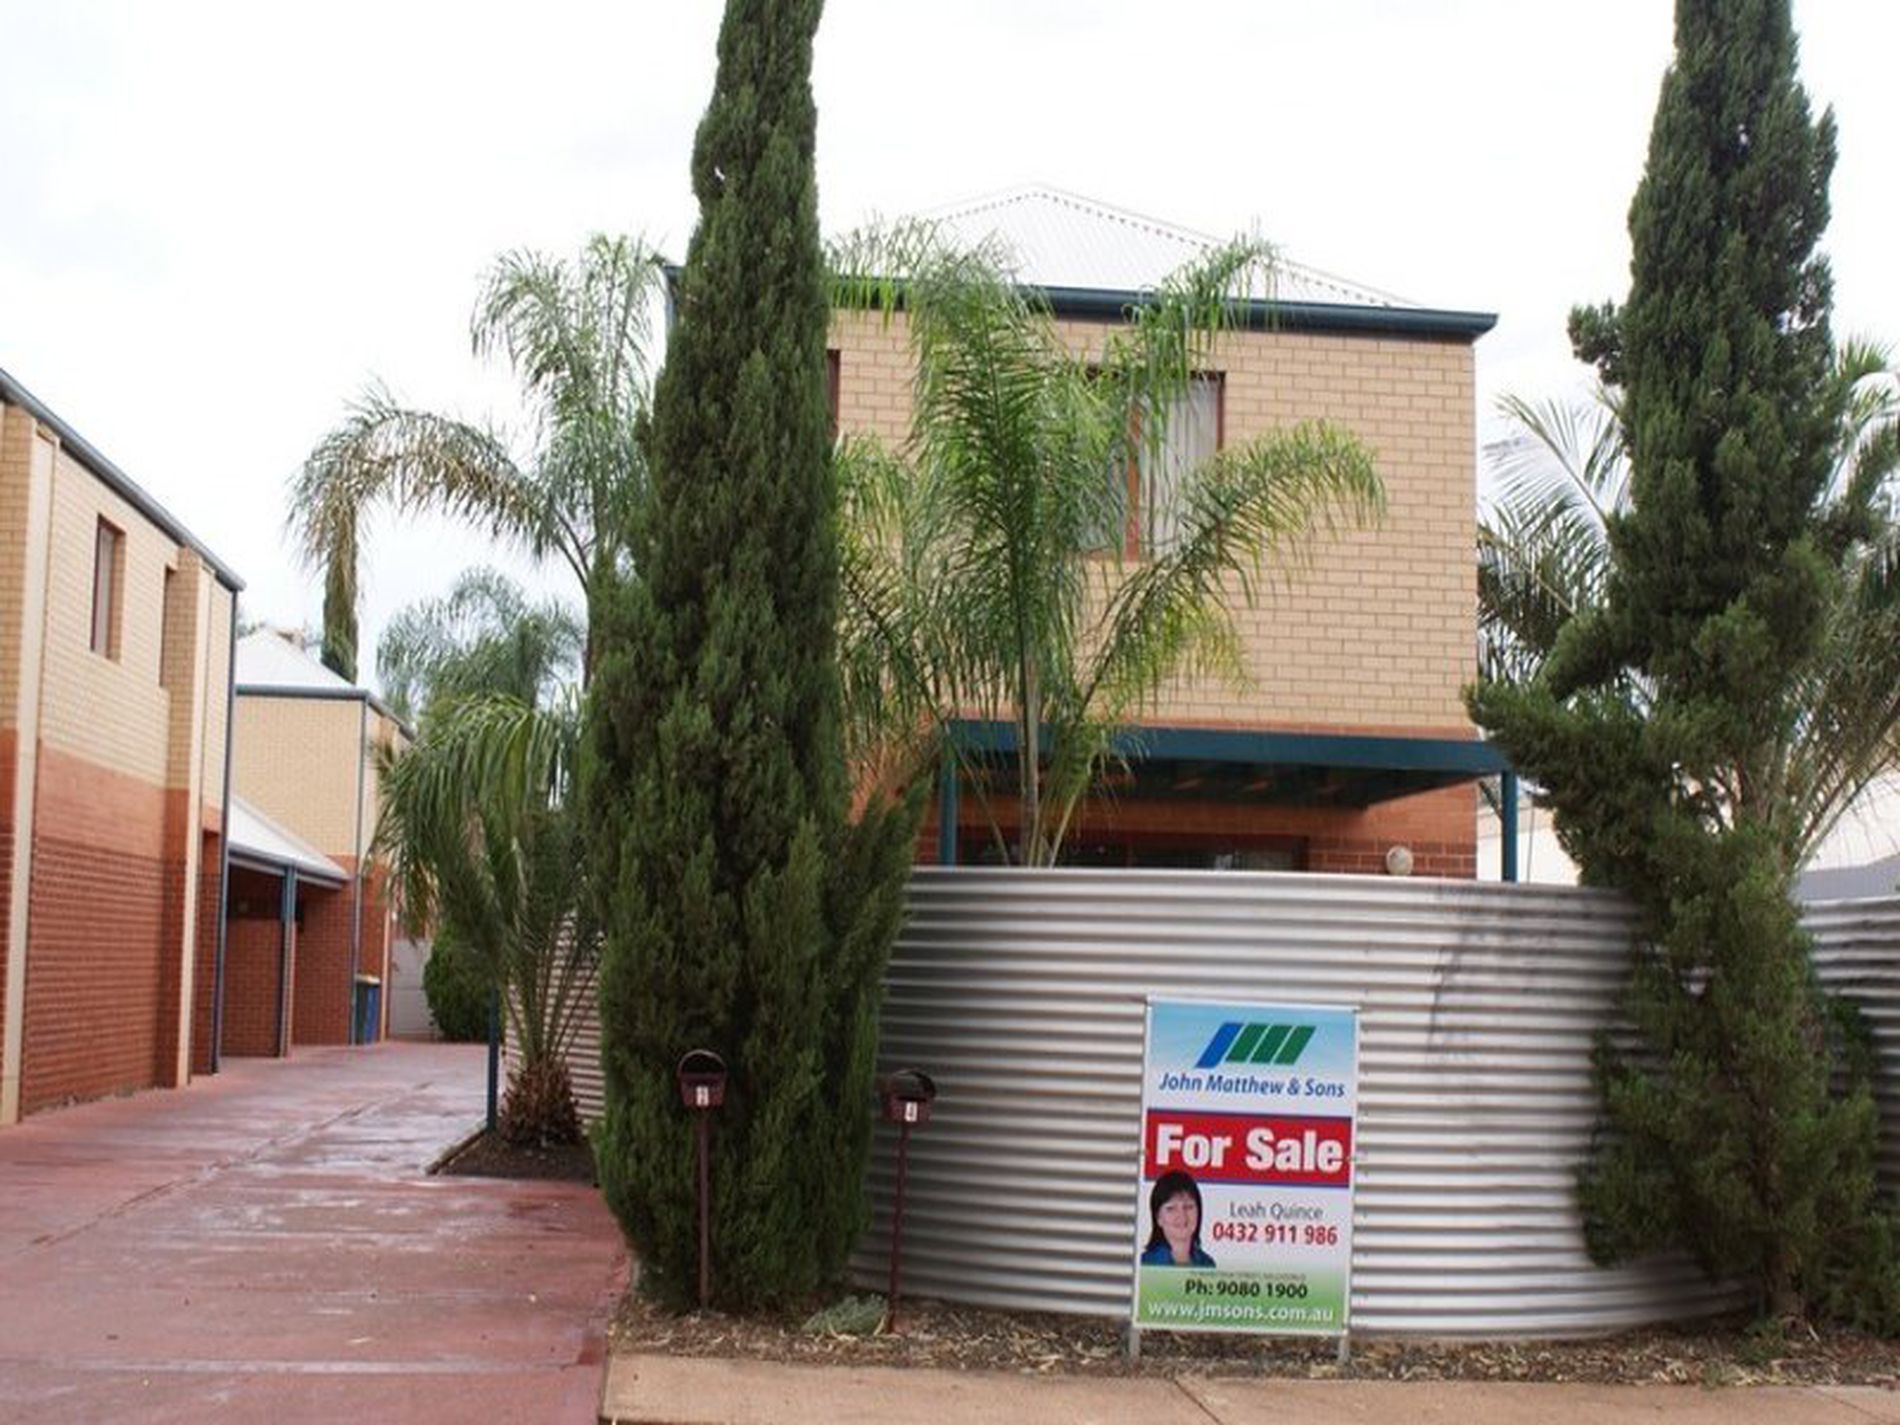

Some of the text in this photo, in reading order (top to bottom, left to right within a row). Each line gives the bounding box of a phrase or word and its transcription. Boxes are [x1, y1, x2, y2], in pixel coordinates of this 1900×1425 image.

[1159, 1073, 1345, 1098] John Matthew & Sons
[1156, 1123, 1344, 1173] For Sale
[1229, 1201, 1323, 1220] Leah Quince
[1212, 1221, 1338, 1245] 0432 911 986
[1185, 1279, 1308, 1299] Ph: 9080 1900
[1147, 1301, 1334, 1322] www.jmsons.com.au
